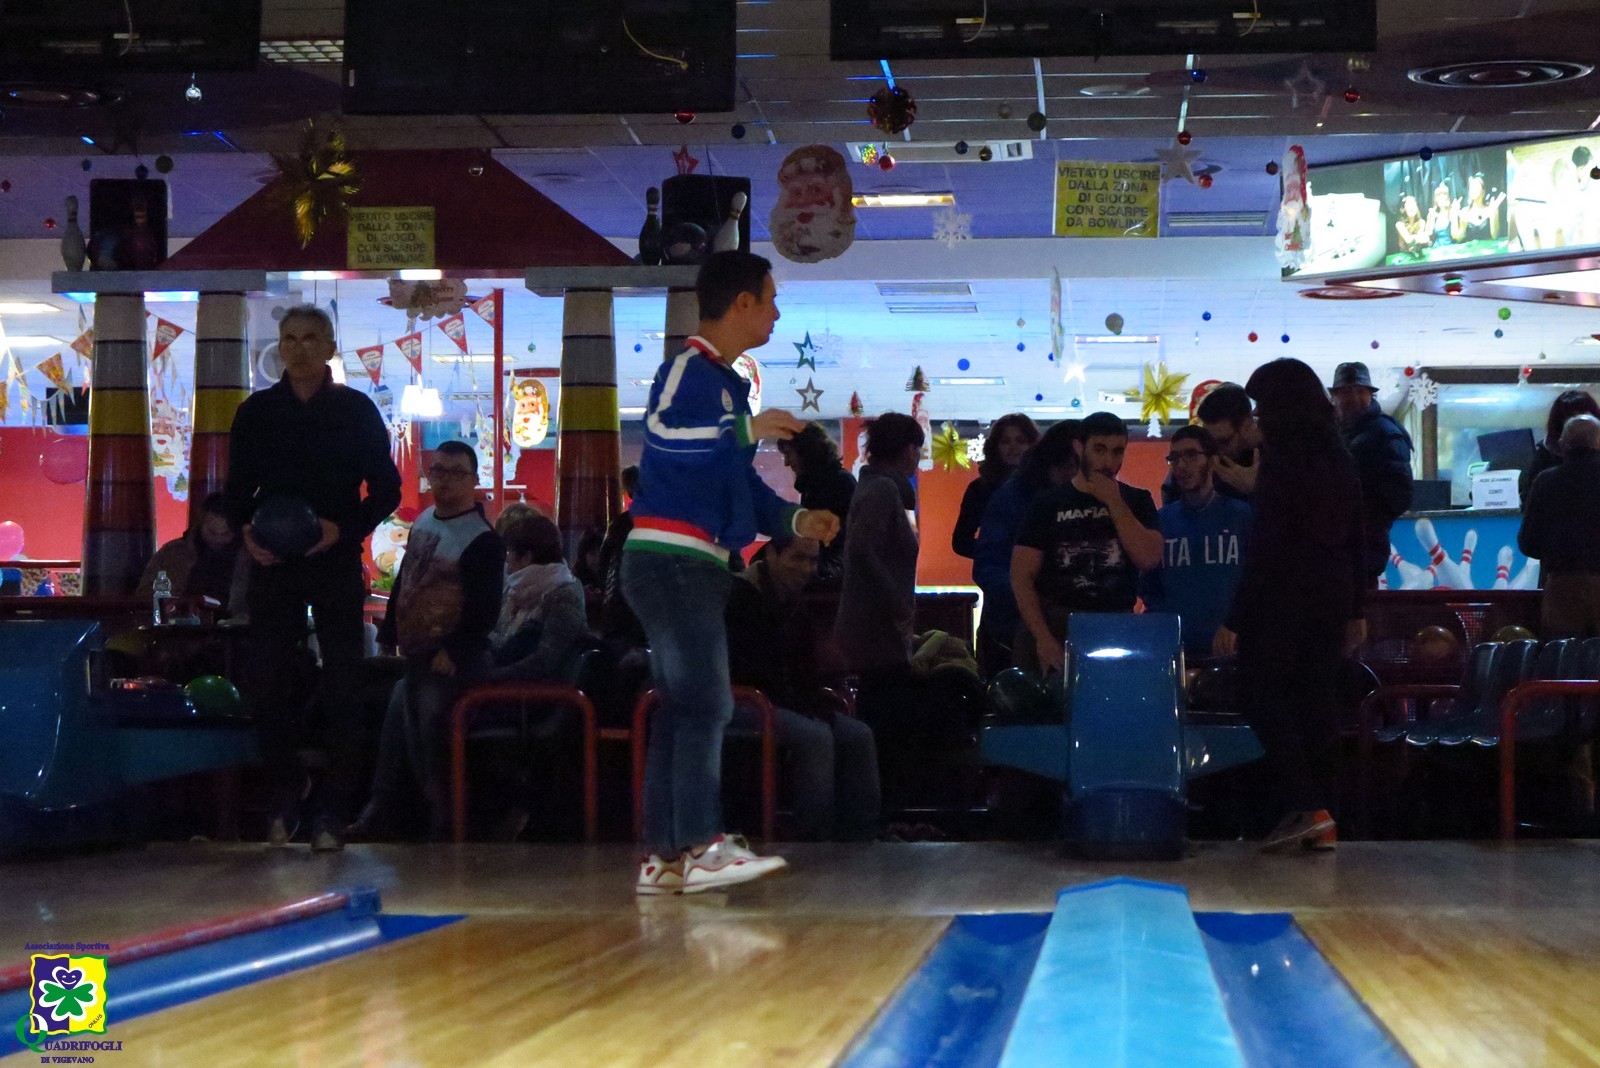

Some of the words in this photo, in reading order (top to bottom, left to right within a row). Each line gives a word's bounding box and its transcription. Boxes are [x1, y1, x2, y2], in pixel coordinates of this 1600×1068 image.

[1058, 167, 1108, 179] VIETATO
[1113, 169, 1160, 181] USCIRE
[1068, 179, 1109, 191] DALLA
[1112, 181, 1149, 193] ZONA
[1078, 192, 1091, 203] DI
[1095, 193, 1138, 205] GIOCO
[1065, 205, 1094, 215] CON
[1098, 206, 1149, 217] SCARPE
[357, 222, 391, 231] DALLA
[394, 222, 426, 231] ZONA
[1066, 217, 1084, 227] DA
[1088, 218, 1148, 230] BOWLING
[366, 233, 377, 242] DI
[381, 232, 416, 241] GIOCO
[356, 243, 380, 253] CON
[383, 243, 426, 253] SCARPE
[357, 254, 372, 263] DA
[376, 253, 426, 263] BOWLING
[1056, 506, 1110, 523] MAFIA
